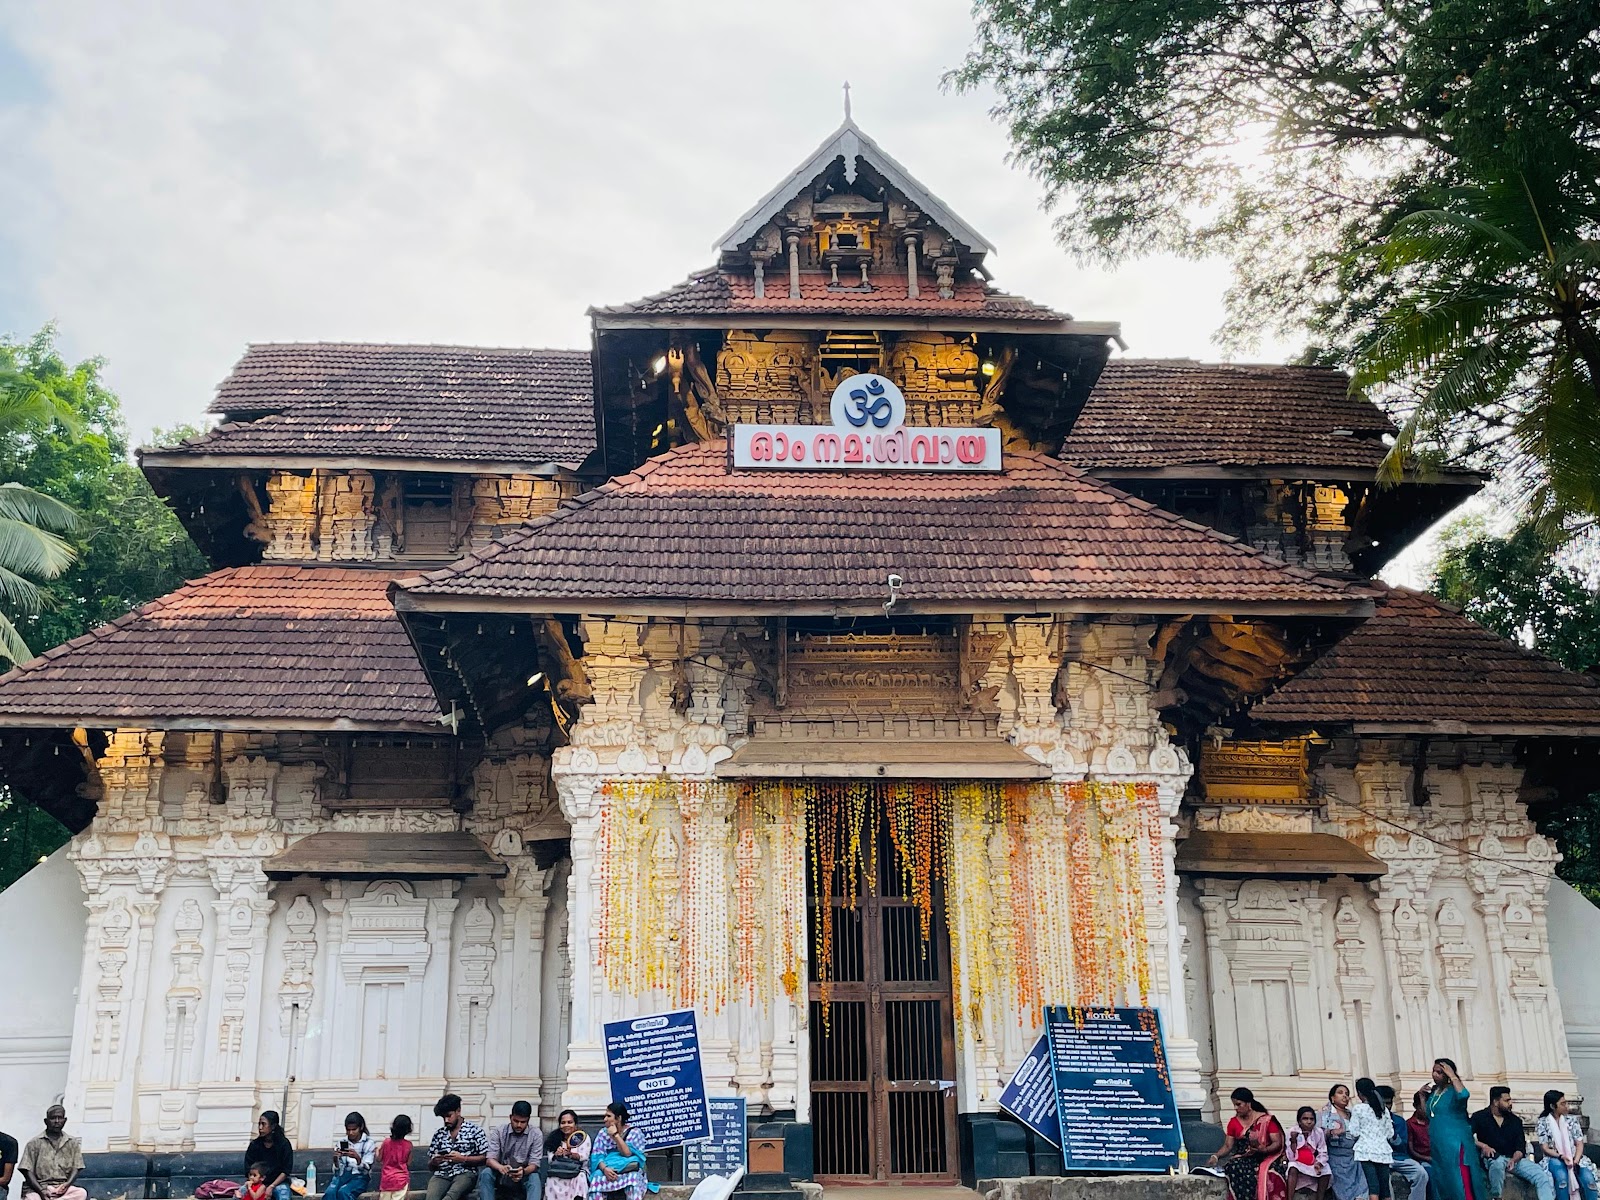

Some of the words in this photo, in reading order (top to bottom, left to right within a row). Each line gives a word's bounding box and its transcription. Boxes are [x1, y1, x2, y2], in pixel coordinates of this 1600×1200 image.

[750, 432, 806, 462] ഓം
[646, 1080, 668, 1088] NOTE
[624, 1094, 646, 1102] USING
[647, 1088, 684, 1098] FOOTWEAR
[644, 1096, 678, 1106] PREMISES
[637, 1099, 702, 1113] WADAKKUNNATHAN
[666, 1106, 698, 1115] STRICTLY
